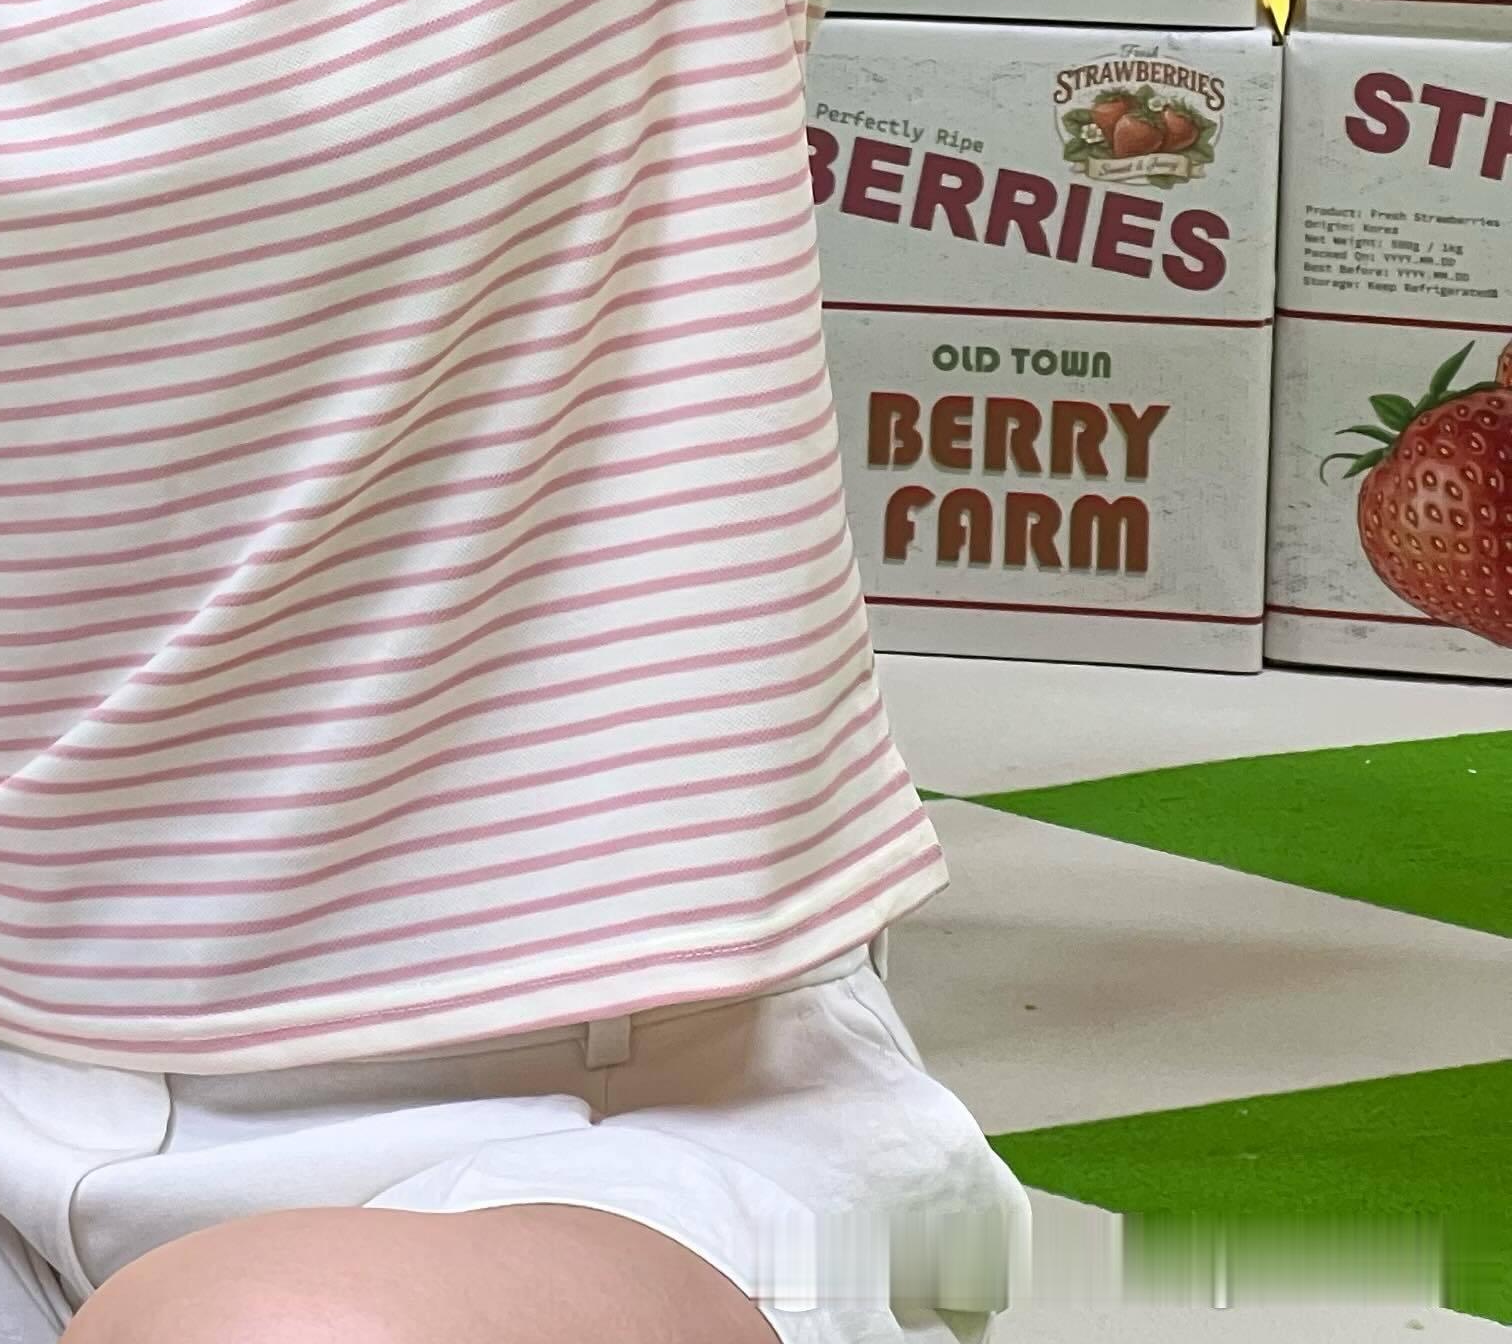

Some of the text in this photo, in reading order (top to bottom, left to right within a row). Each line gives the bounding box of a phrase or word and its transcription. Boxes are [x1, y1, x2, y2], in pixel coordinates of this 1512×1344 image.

[1053, 61, 1225, 111] STRAWBERRIES
[815, 101, 985, 155] Perfectly Ripe
[932, 344, 1112, 379] OLD TOWN
[866, 390, 1171, 480] BERRY
[882, 485, 1150, 574] FARM
